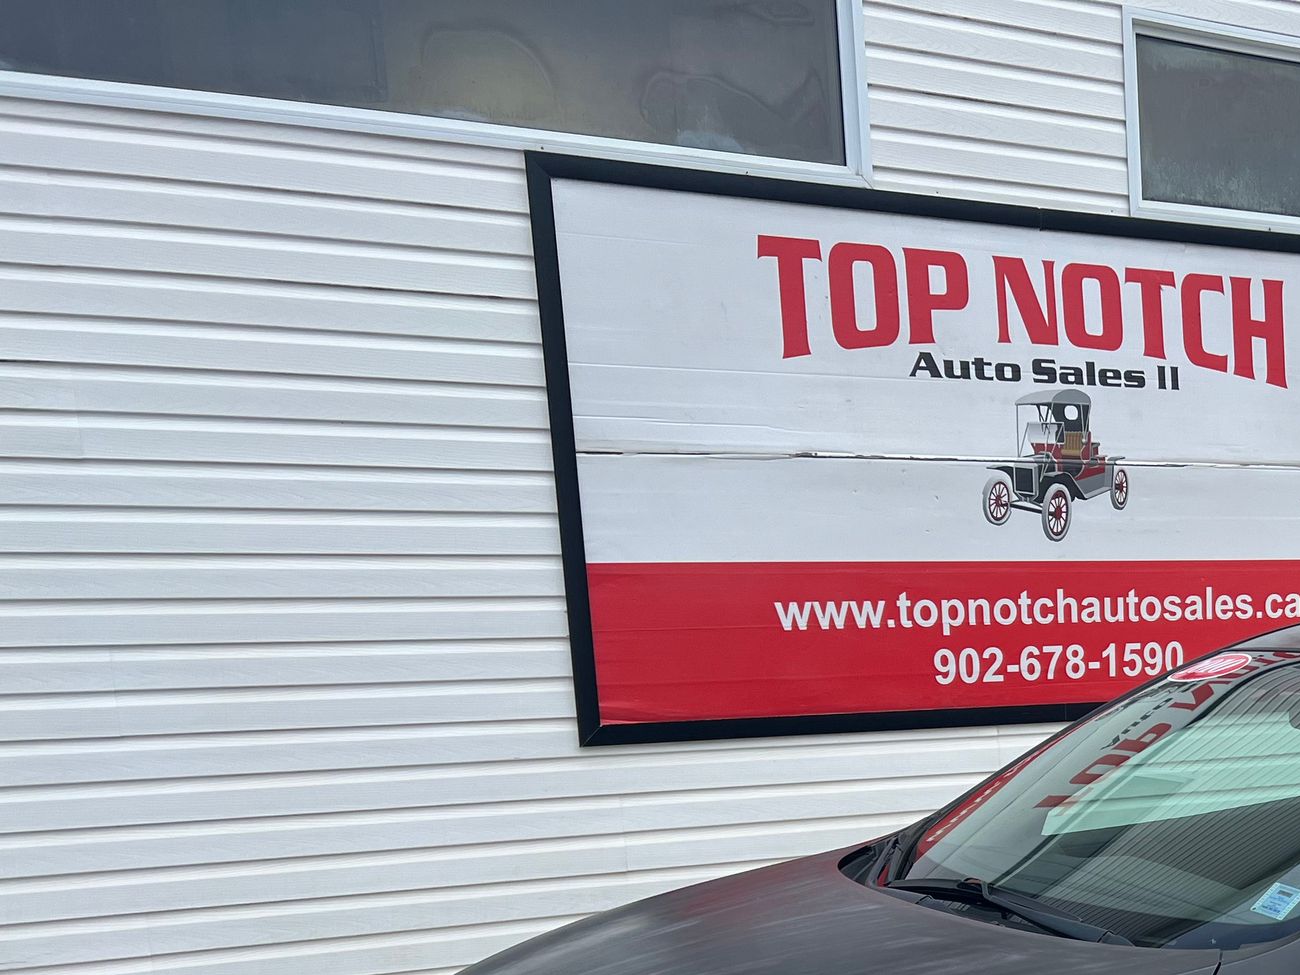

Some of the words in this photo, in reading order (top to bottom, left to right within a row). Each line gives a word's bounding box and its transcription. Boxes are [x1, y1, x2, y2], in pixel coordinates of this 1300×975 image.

[757, 235, 969, 359] TOP
[992, 255, 1288, 389] NOTCH
[909, 352, 1021, 382] Auto
[1032, 359, 1145, 388] Sales
[1157, 365, 1179, 390] II
[933, 641, 1183, 685] 902-678-1590
